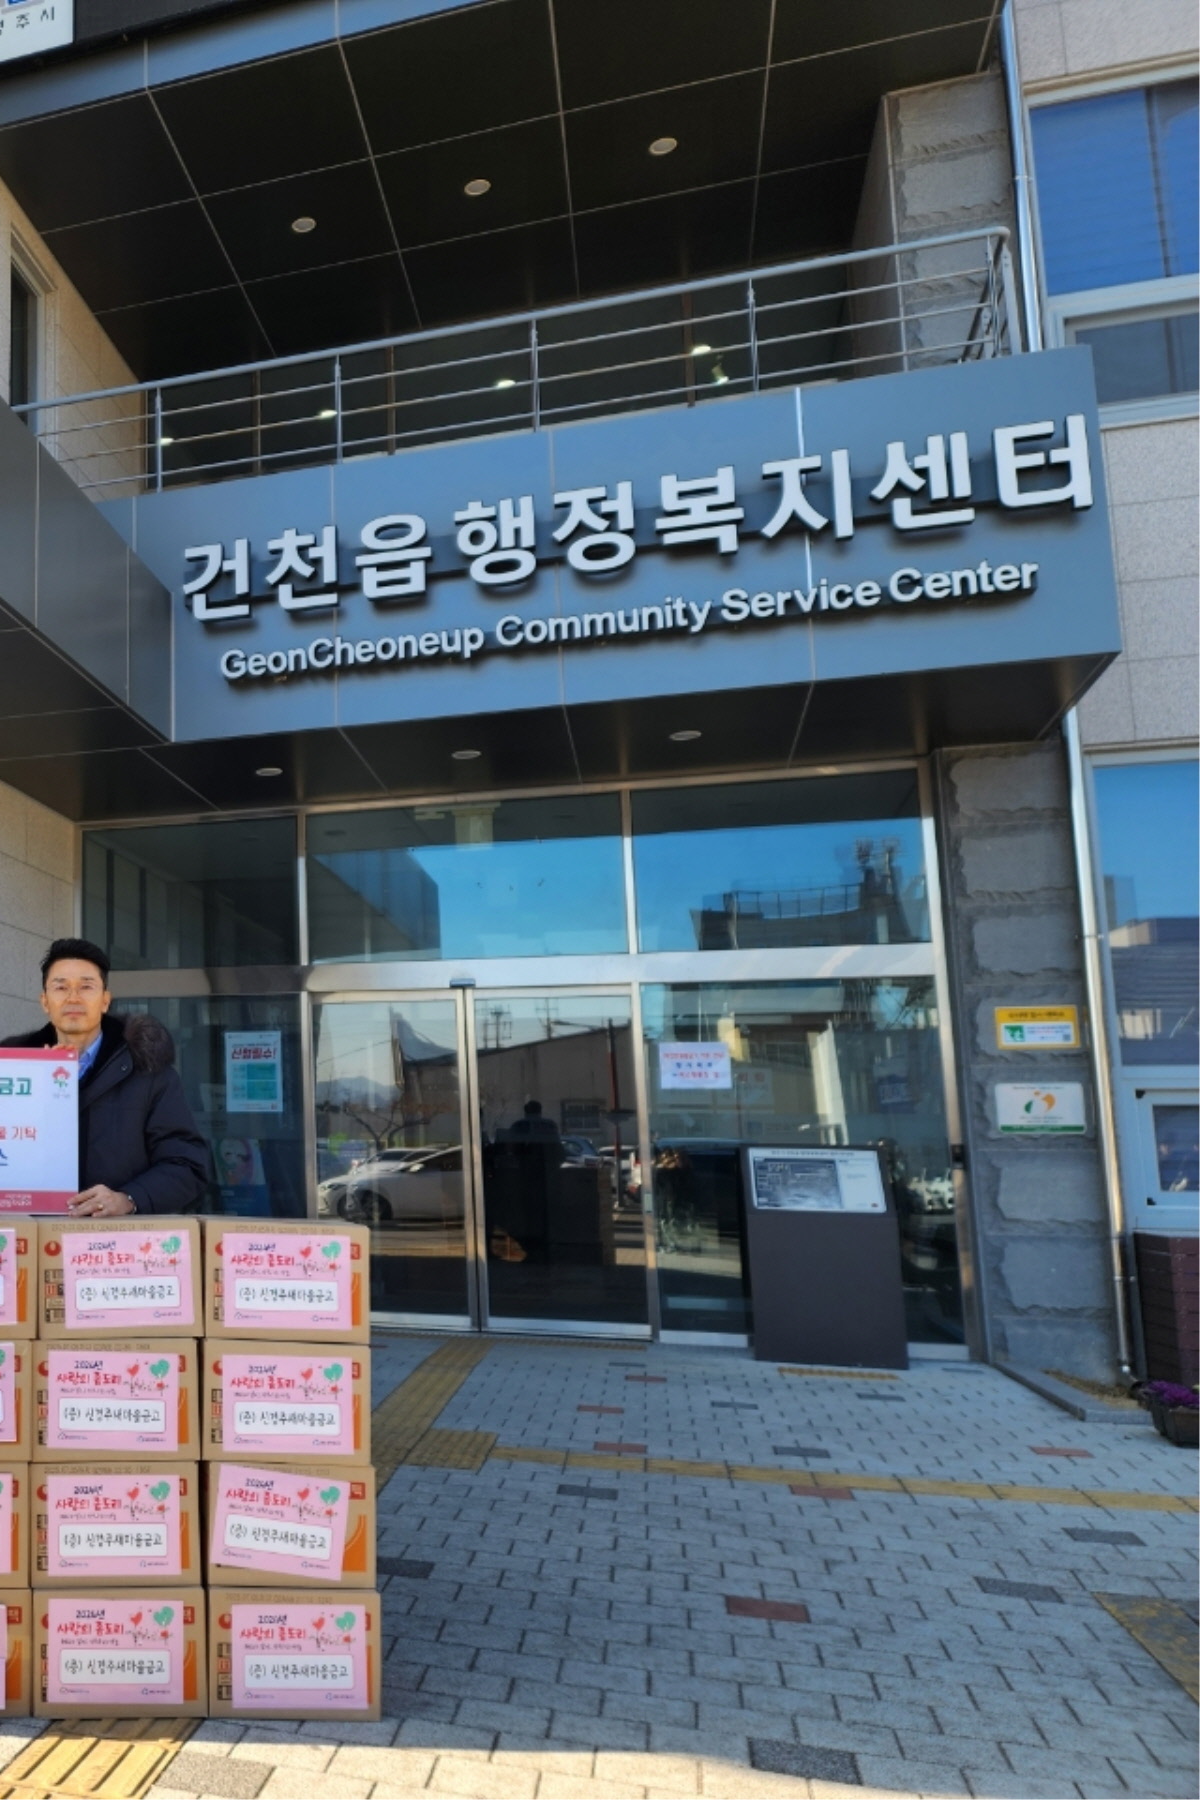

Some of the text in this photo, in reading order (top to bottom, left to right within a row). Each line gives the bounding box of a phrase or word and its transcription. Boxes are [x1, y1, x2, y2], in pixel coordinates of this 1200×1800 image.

[220, 557, 1038, 682] GeonCheoneup Community Service Center
[11, 1126, 37, 1141] 기탁
